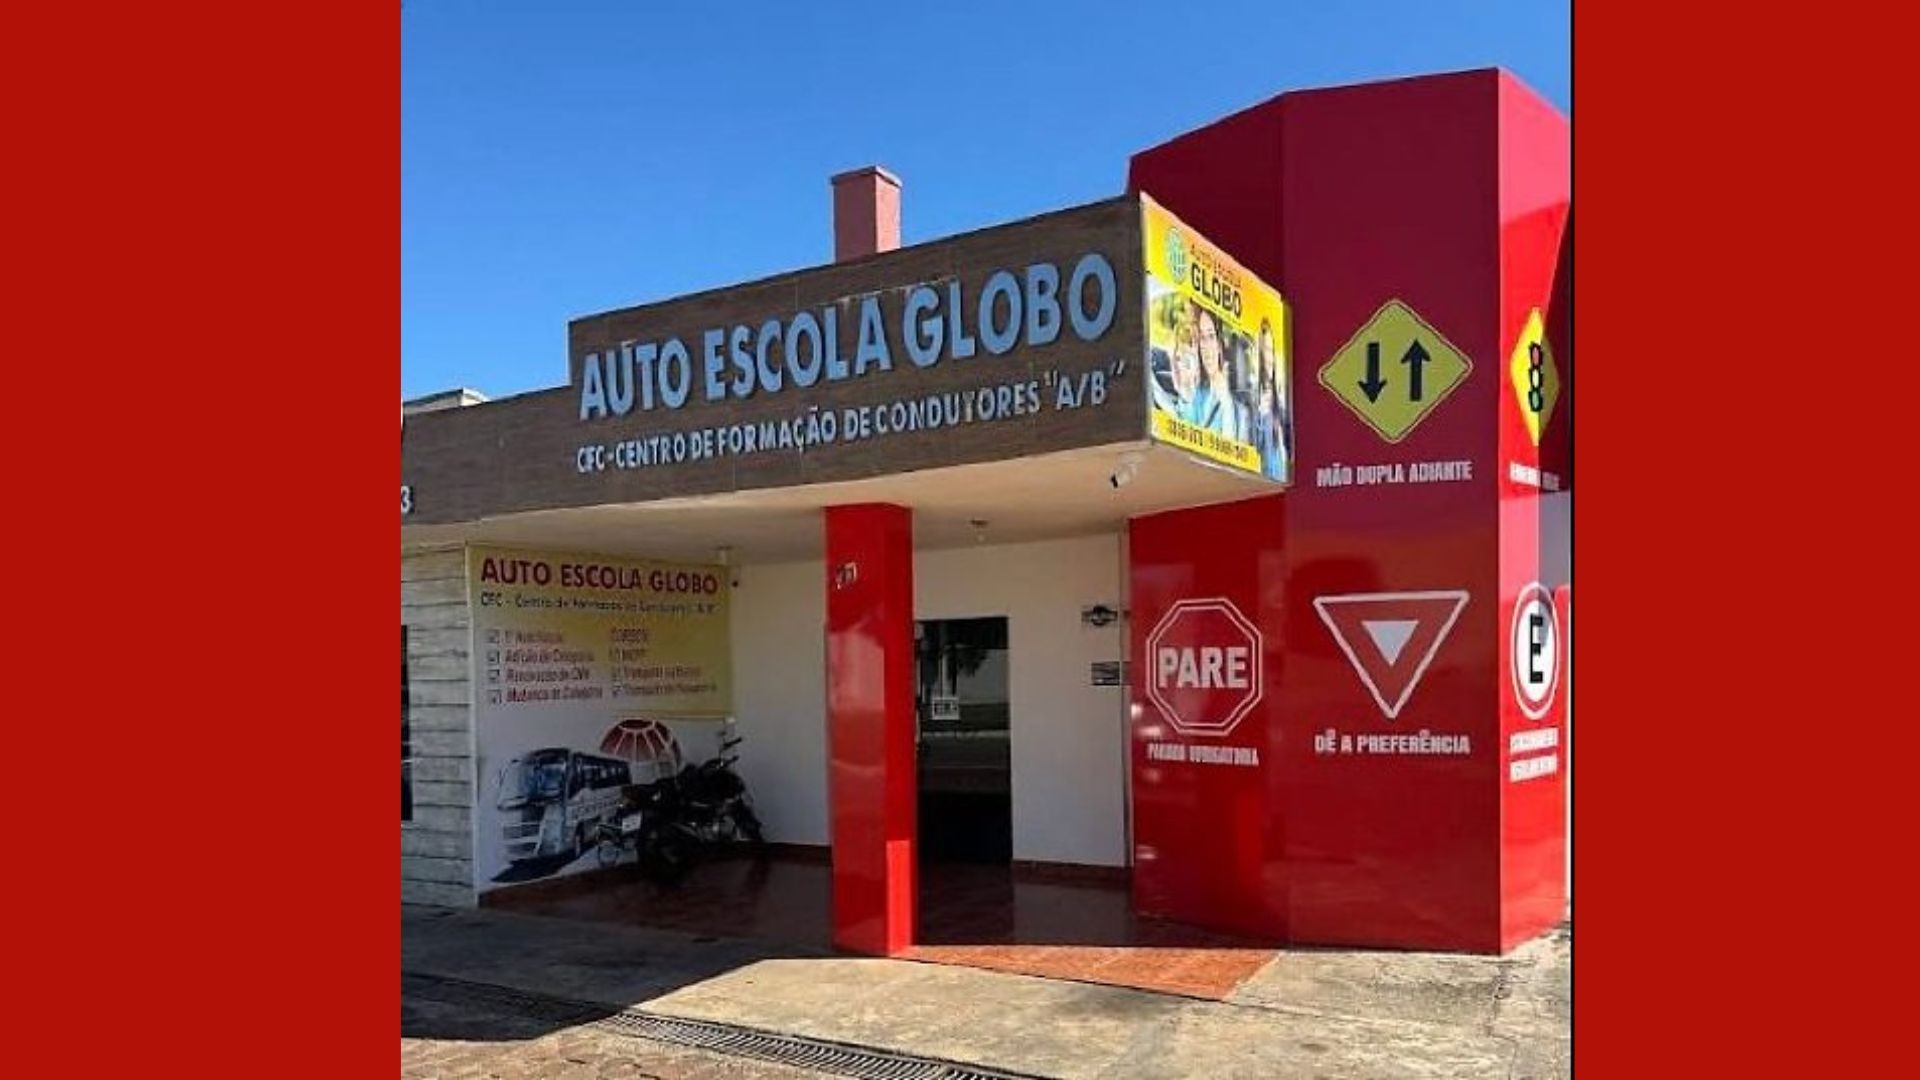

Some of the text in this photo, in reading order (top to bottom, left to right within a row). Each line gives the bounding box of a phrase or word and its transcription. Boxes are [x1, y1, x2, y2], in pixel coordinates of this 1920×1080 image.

[1191, 262, 1242, 318] GLOBO
[579, 337, 691, 421] AUTO
[704, 297, 892, 400] ESCOLA
[903, 253, 1117, 368] GLOBO
[692, 428, 713, 460] DE
[844, 406, 871, 441] DE
[875, 380, 1040, 435] CONDUTORES
[1356, 463, 1405, 486] DUPLA
[1409, 460, 1474, 484] ADIANTE
[481, 557, 719, 595] AUTO ESCOLA GLOBO
[1157, 646, 1249, 689] PARE
[1529, 612, 1544, 684] E
[1313, 728, 1472, 755] DÊ A PREFERÊNCIA
